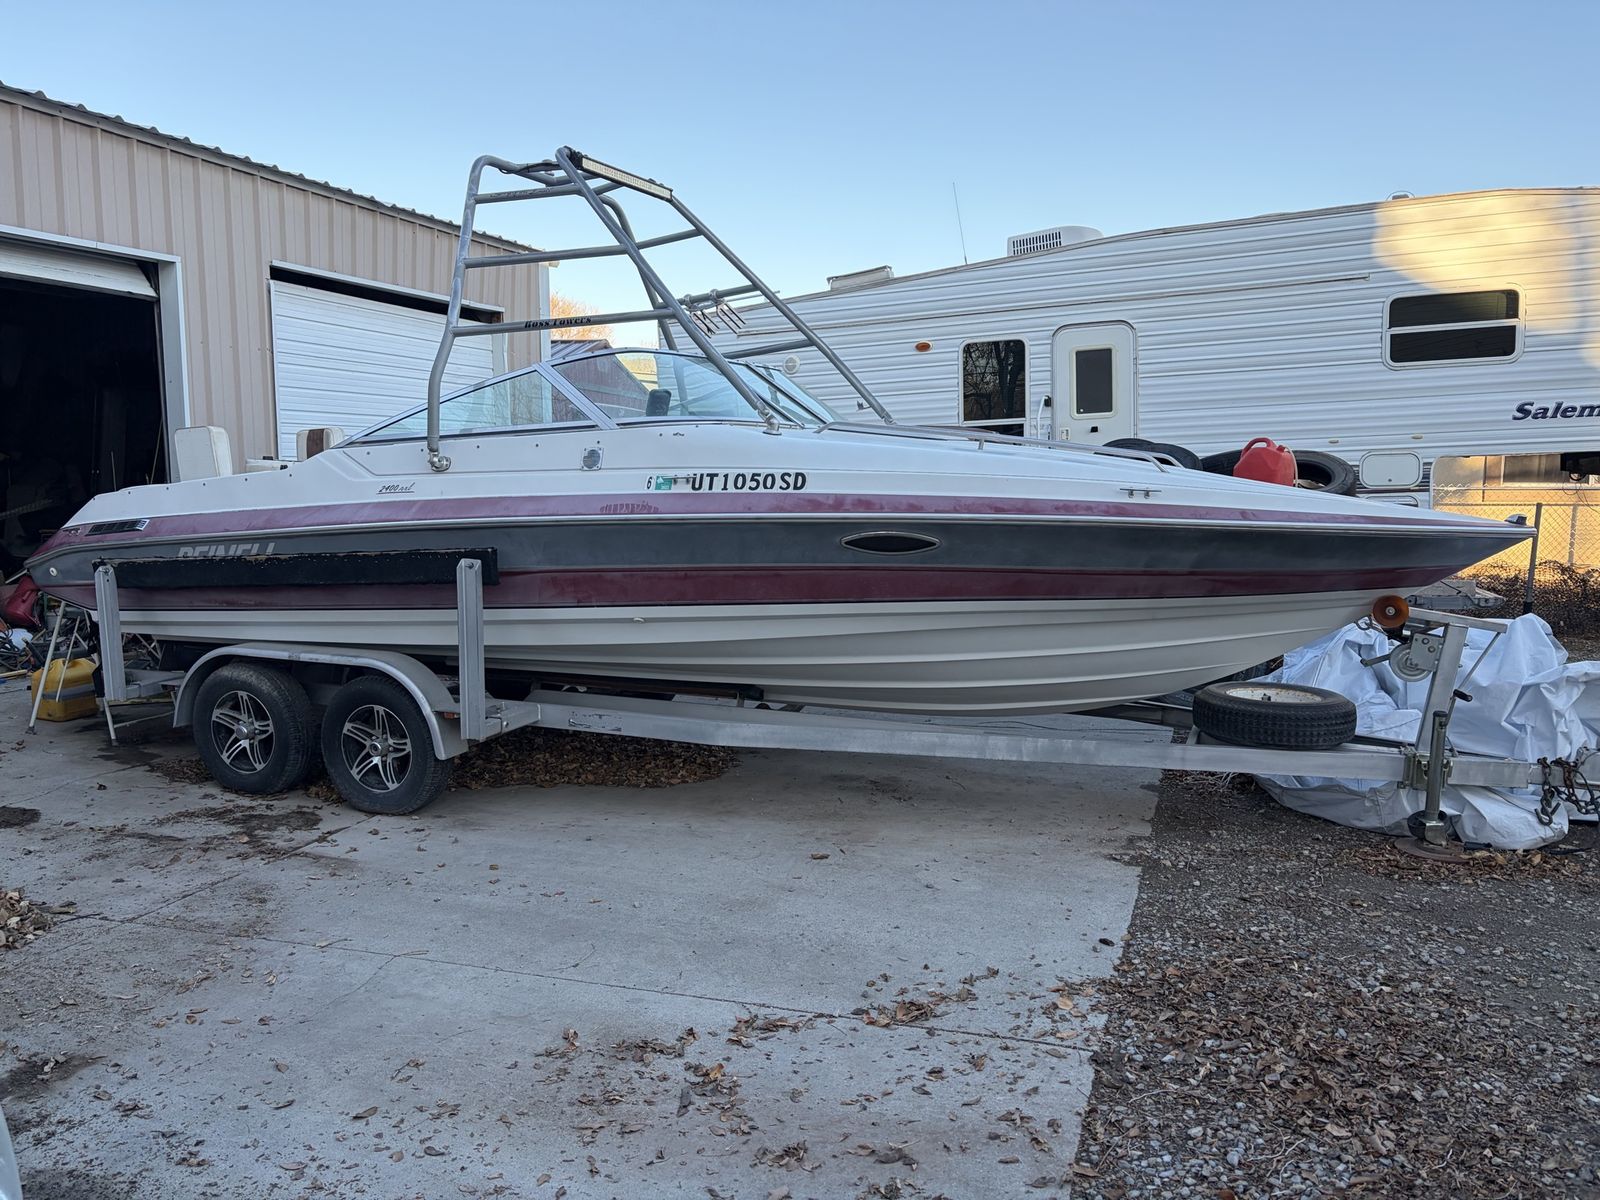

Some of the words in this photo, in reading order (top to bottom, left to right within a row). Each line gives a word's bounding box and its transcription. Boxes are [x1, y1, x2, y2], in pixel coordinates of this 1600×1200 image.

[553, 317, 592, 326] Towers
[1512, 401, 1600, 420] Salem
[646, 476, 653, 489] 6
[691, 472, 807, 491] UT1050SD
